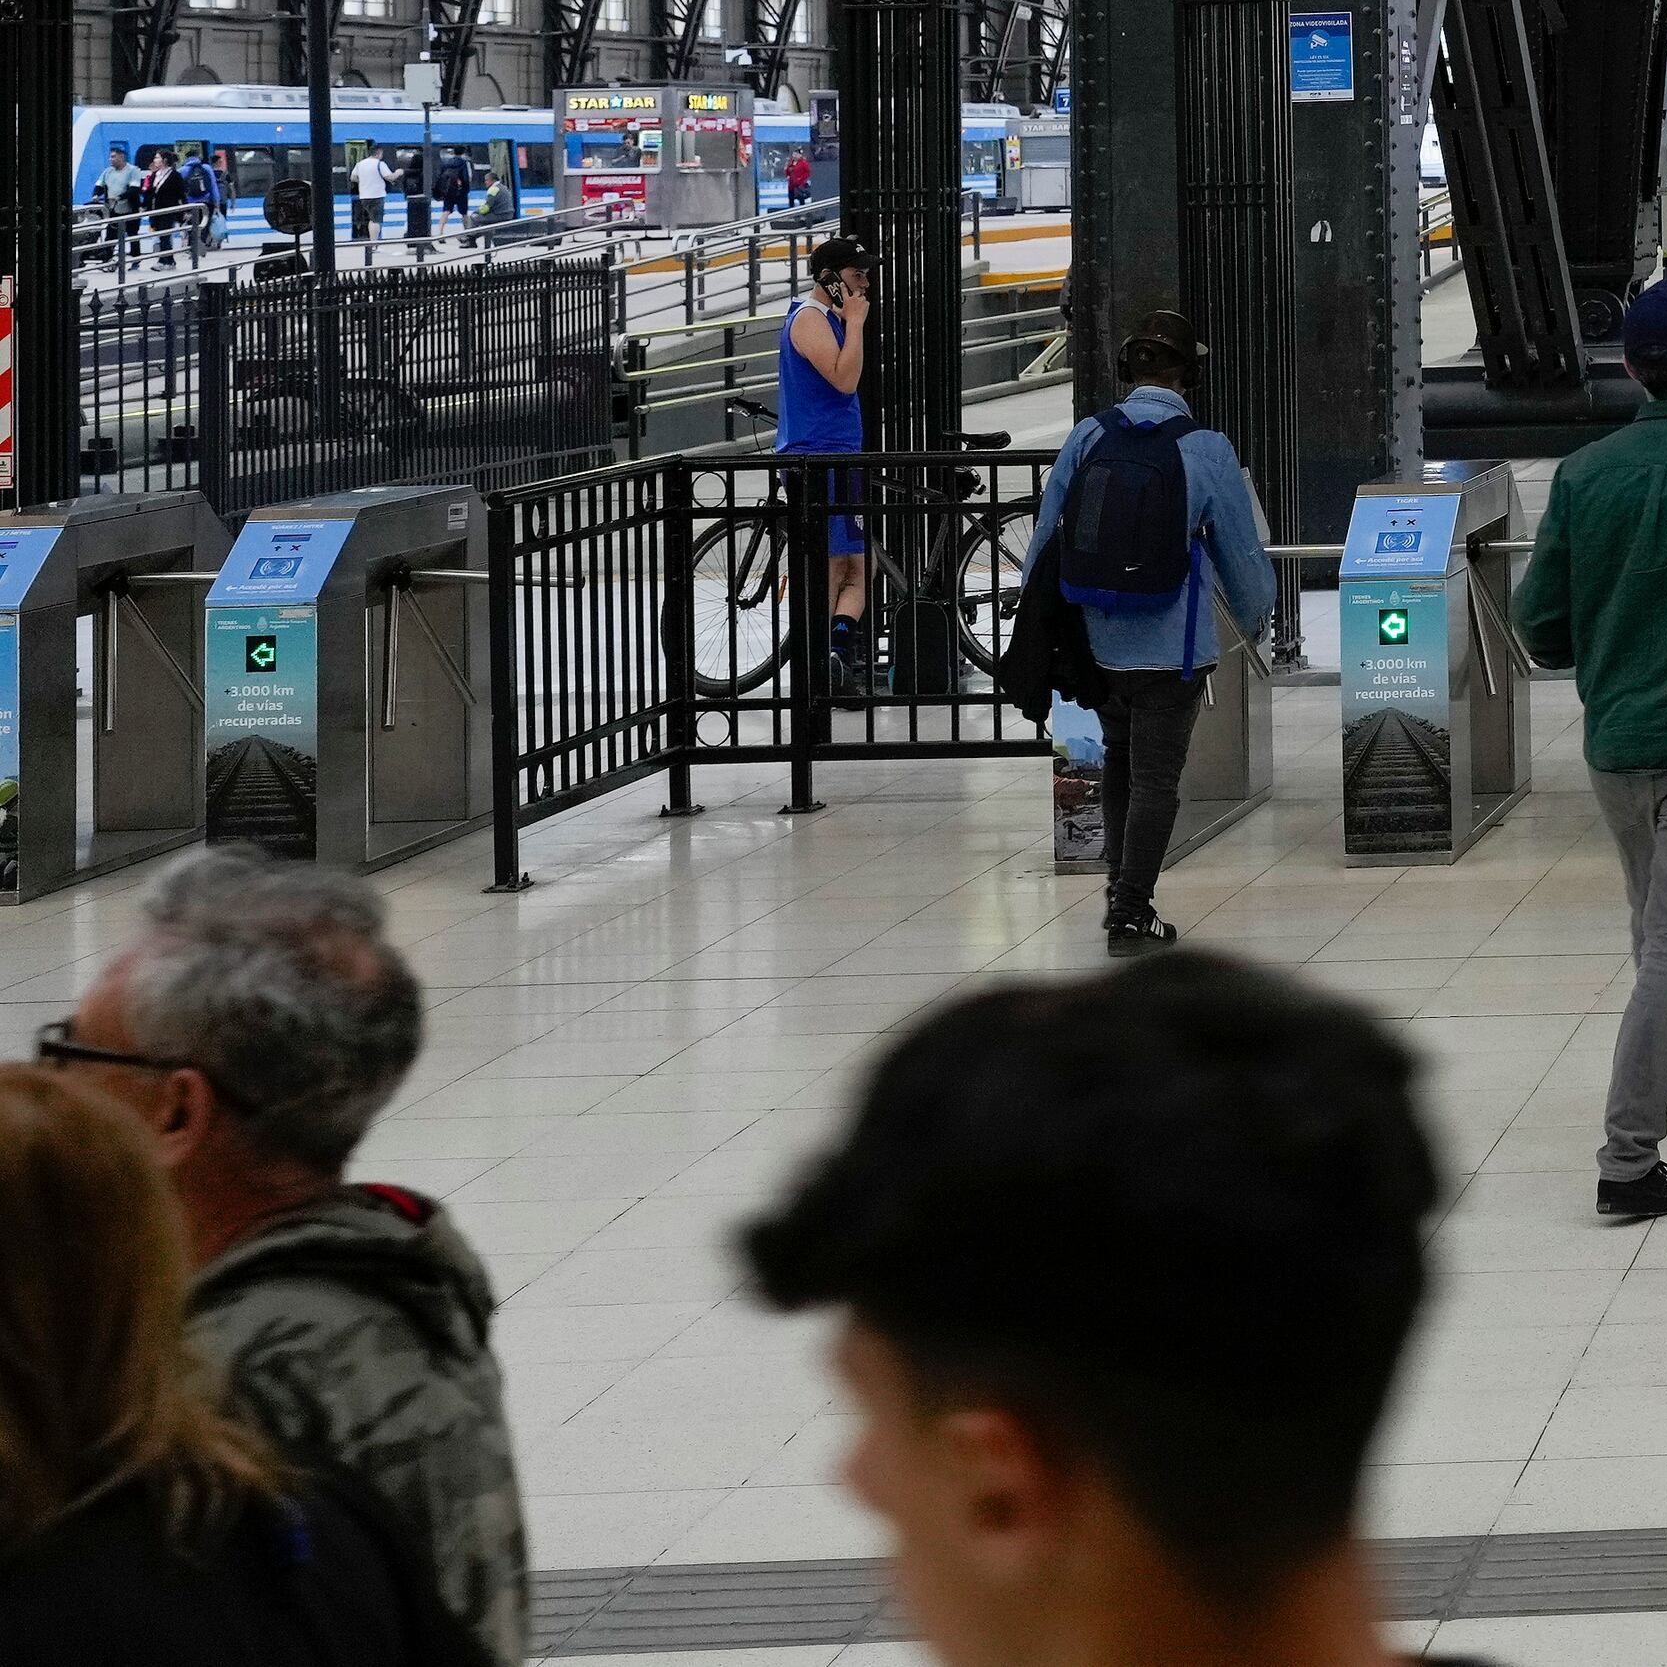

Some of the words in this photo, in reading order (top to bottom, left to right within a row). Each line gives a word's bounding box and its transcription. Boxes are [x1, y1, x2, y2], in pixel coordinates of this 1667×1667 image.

[569, 96, 609, 110] STAR
[622, 96, 655, 108] BAR
[688, 95, 708, 110] STAR
[714, 95, 728, 110] BAR
[1407, 658, 1426, 669] km
[1373, 673, 1388, 684] de
[1391, 673, 1416, 684] vías
[273, 685, 294, 696] km
[1355, 687, 1435, 701] recuperadas
[237, 700, 254, 712] de
[256, 700, 283, 711] vías
[219, 714, 302, 728] recuperadas
